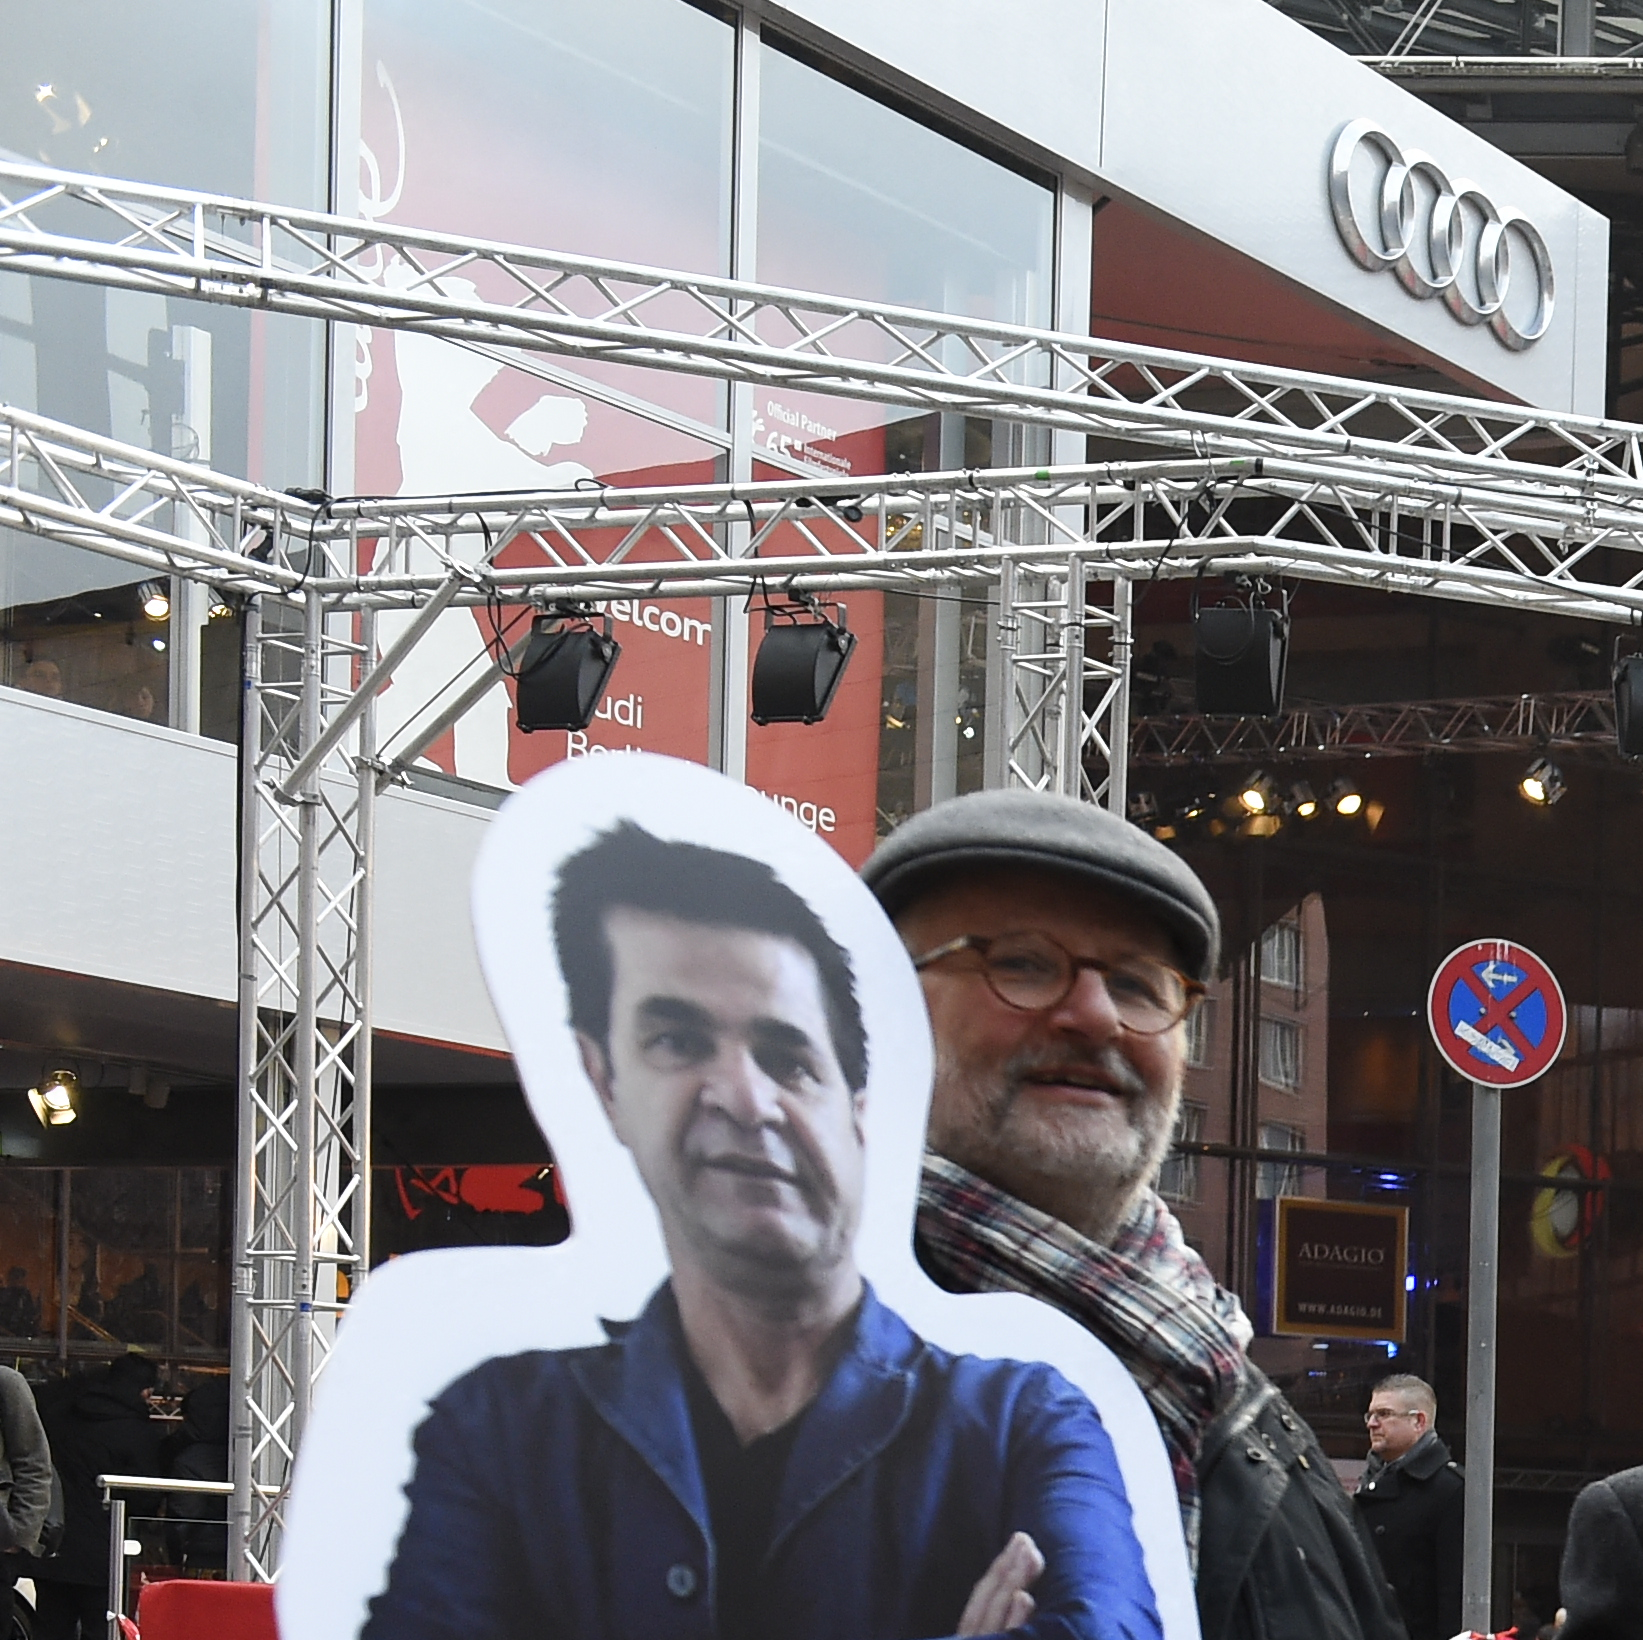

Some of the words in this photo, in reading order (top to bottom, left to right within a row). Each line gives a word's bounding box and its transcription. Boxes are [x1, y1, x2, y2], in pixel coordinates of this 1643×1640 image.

[767, 400, 799, 428] Official
[801, 414, 837, 441] Partner
[1298, 1241, 1386, 1265] ADAGIO
